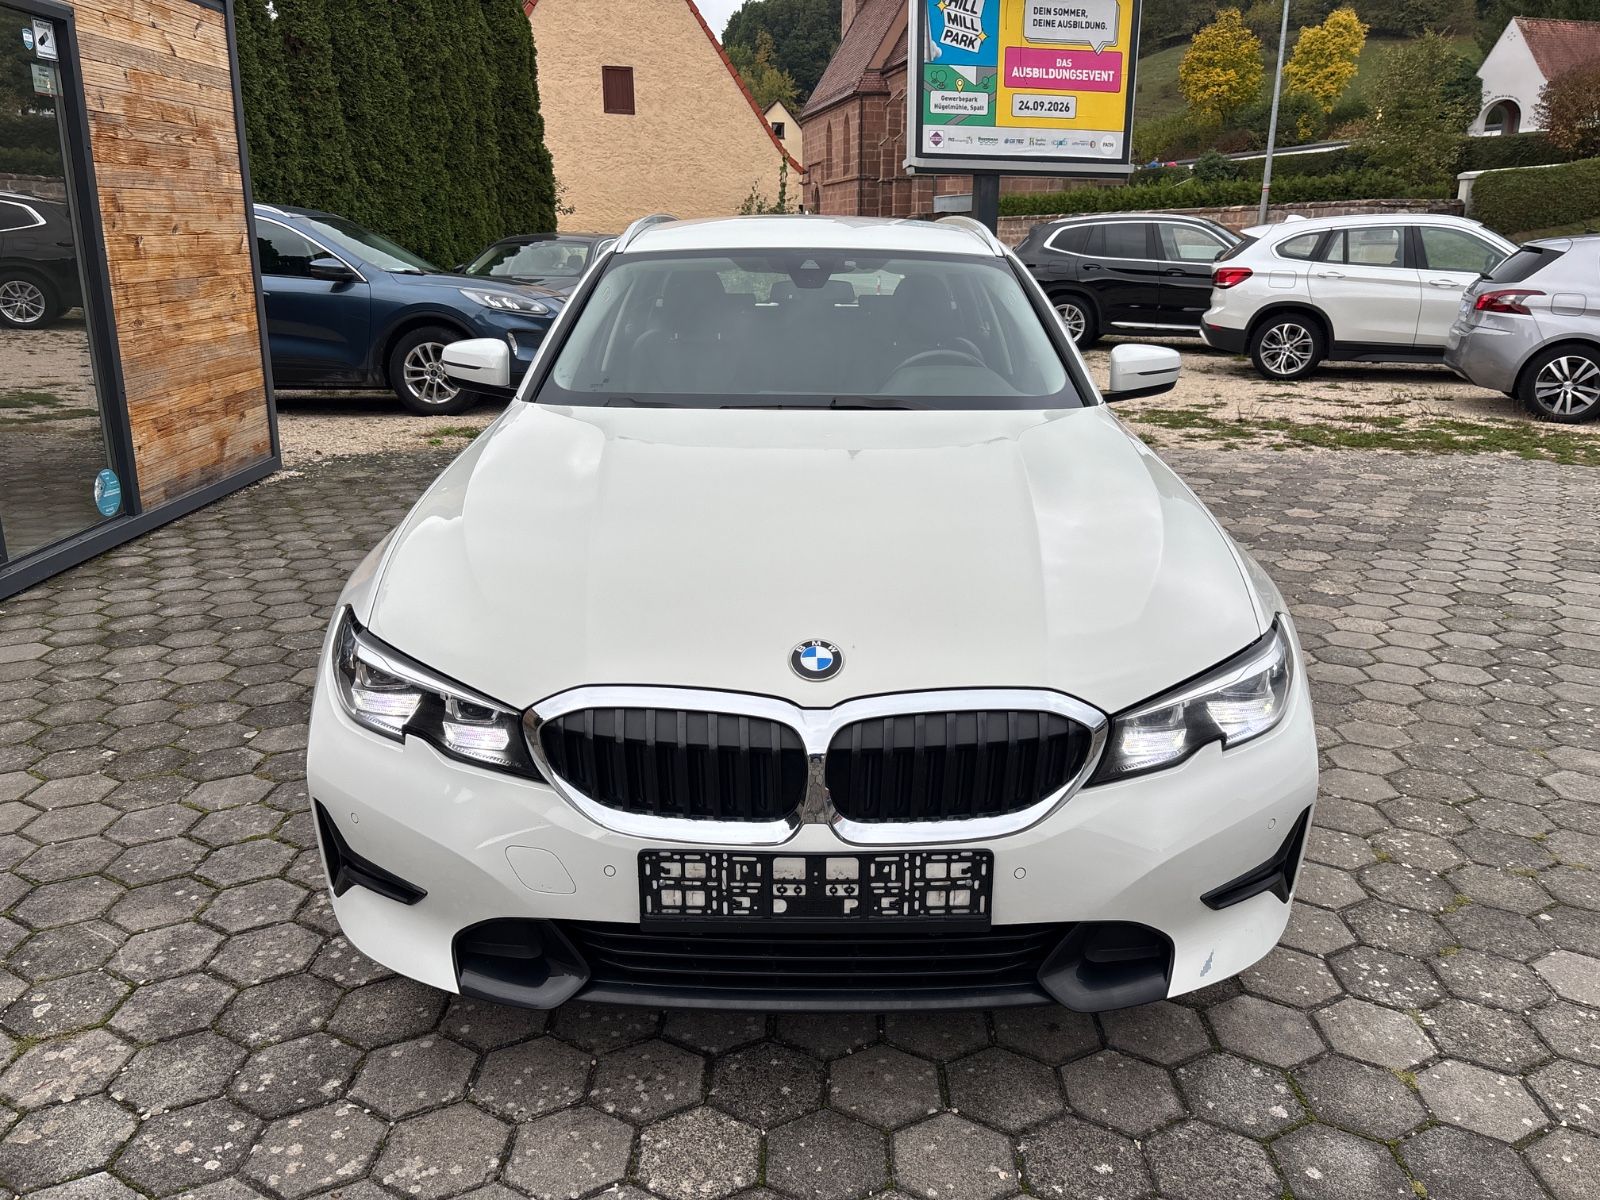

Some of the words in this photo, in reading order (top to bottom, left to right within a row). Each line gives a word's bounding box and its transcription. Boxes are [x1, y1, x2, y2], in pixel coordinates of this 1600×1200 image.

[1033, 7, 1052, 16] DEIN
[1053, 8, 1088, 18] SOMMER,
[947, 12, 978, 32] MILL
[1032, 19, 1056, 28] DEINE
[1057, 20, 1107, 30] AUSBILDUNG.
[943, 30, 977, 49] PARK
[1056, 59, 1072, 67] DAS
[1012, 68, 1115, 82] AUSBILDUNGSEVENT
[940, 95, 978, 104] Gewerbepark
[934, 103, 969, 112] Hügelmühle,
[1018, 100, 1070, 113] 24.09.2026
[796, 641, 838, 653] BMW
